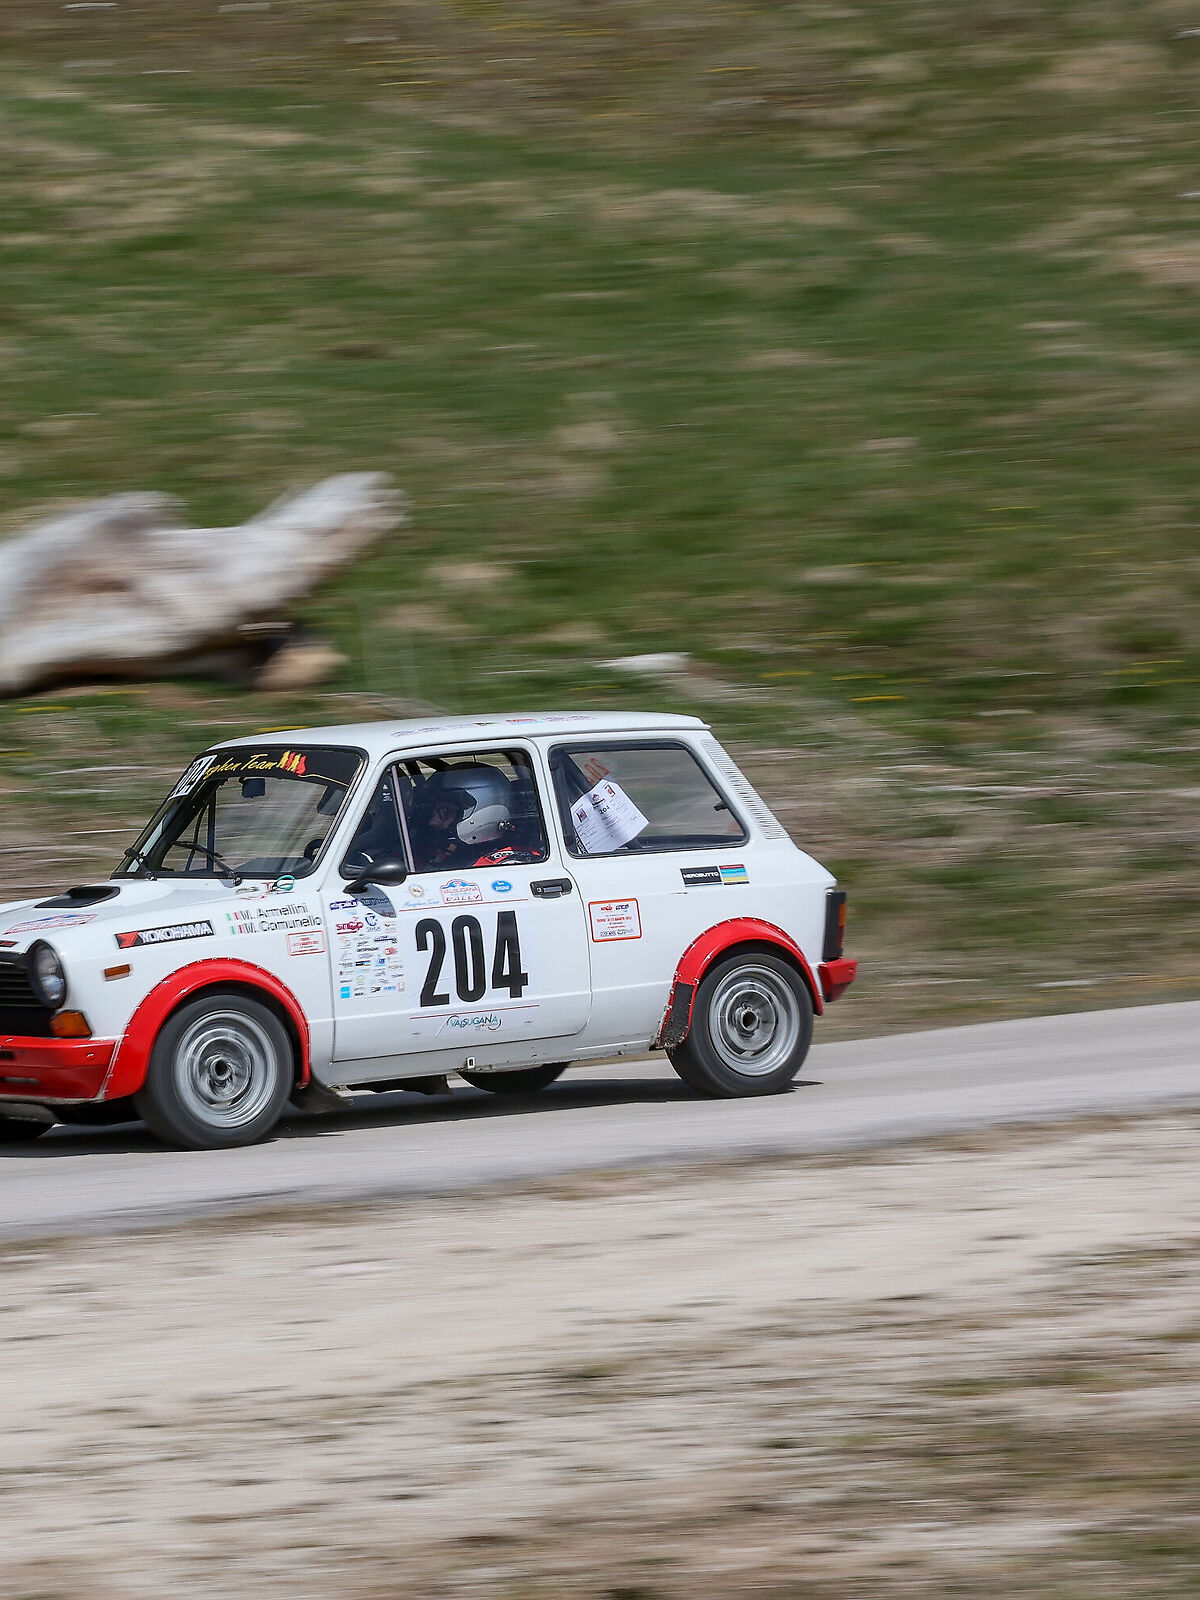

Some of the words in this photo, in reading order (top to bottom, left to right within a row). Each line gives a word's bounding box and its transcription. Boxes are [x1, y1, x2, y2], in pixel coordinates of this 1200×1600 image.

[240, 754, 278, 771] Team
[257, 902, 309, 919] Armellini
[259, 915, 323, 932] Comunello
[137, 922, 214, 945] YOKOHAMA
[415, 910, 529, 1008] 204
[450, 1013, 498, 1028] VALSUGANA
